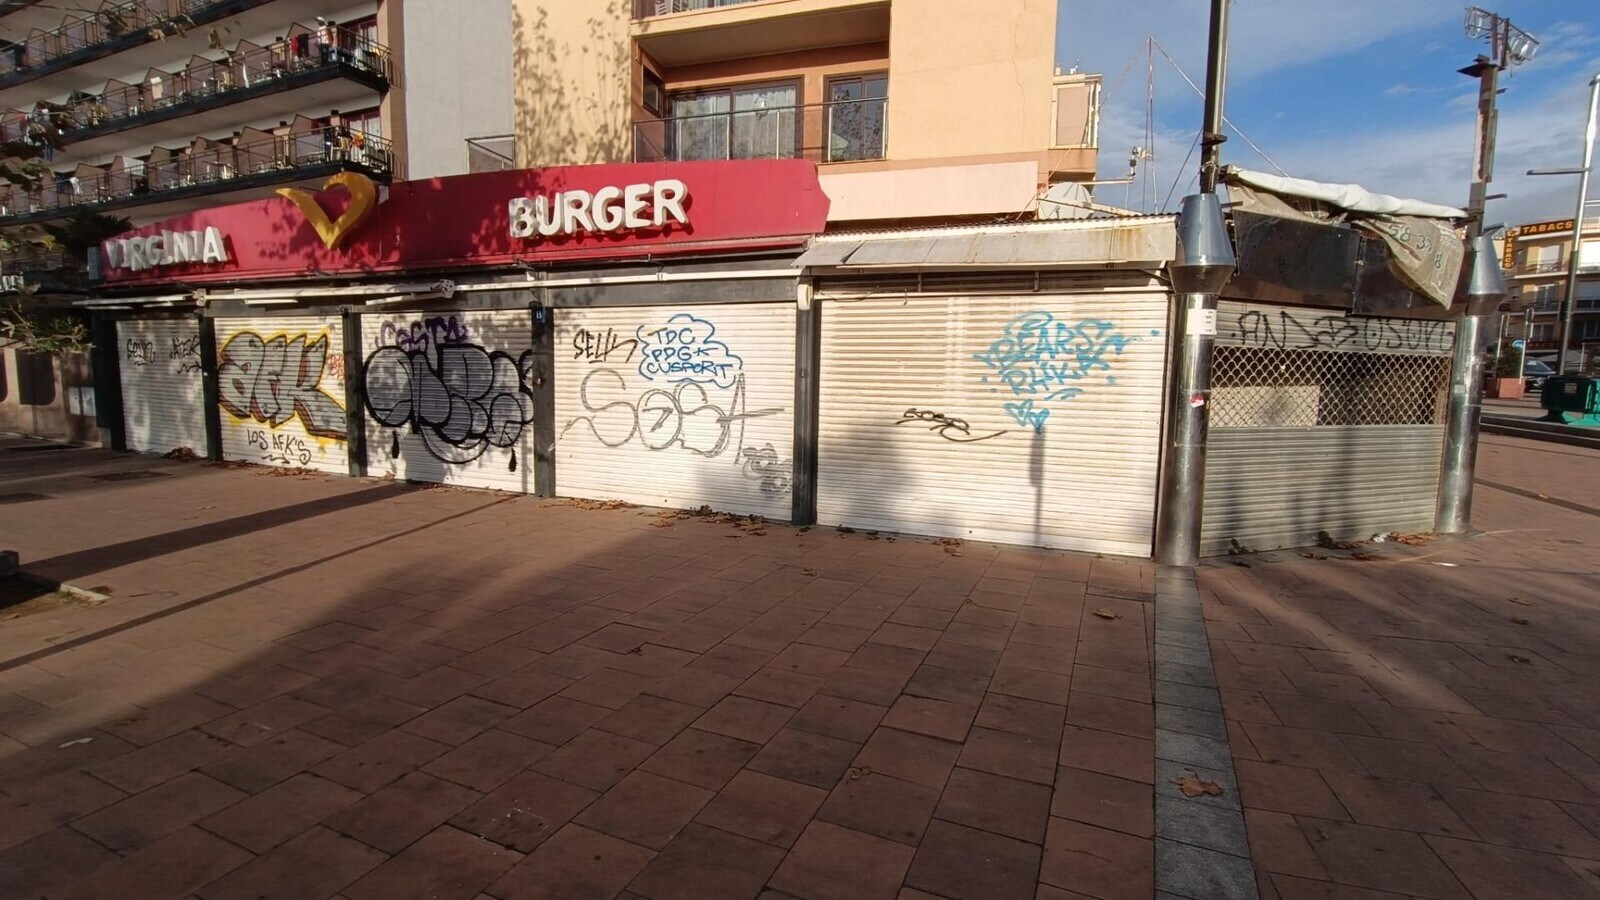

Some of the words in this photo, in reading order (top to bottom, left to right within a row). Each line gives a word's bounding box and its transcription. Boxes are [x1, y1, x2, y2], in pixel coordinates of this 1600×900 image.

[508, 179, 690, 239] BURGER
[1522, 221, 1574, 235] TABACS
[105, 226, 228, 272] VIRGINIA
[647, 327, 696, 345] TDC
[247, 429, 269, 450] LOS
